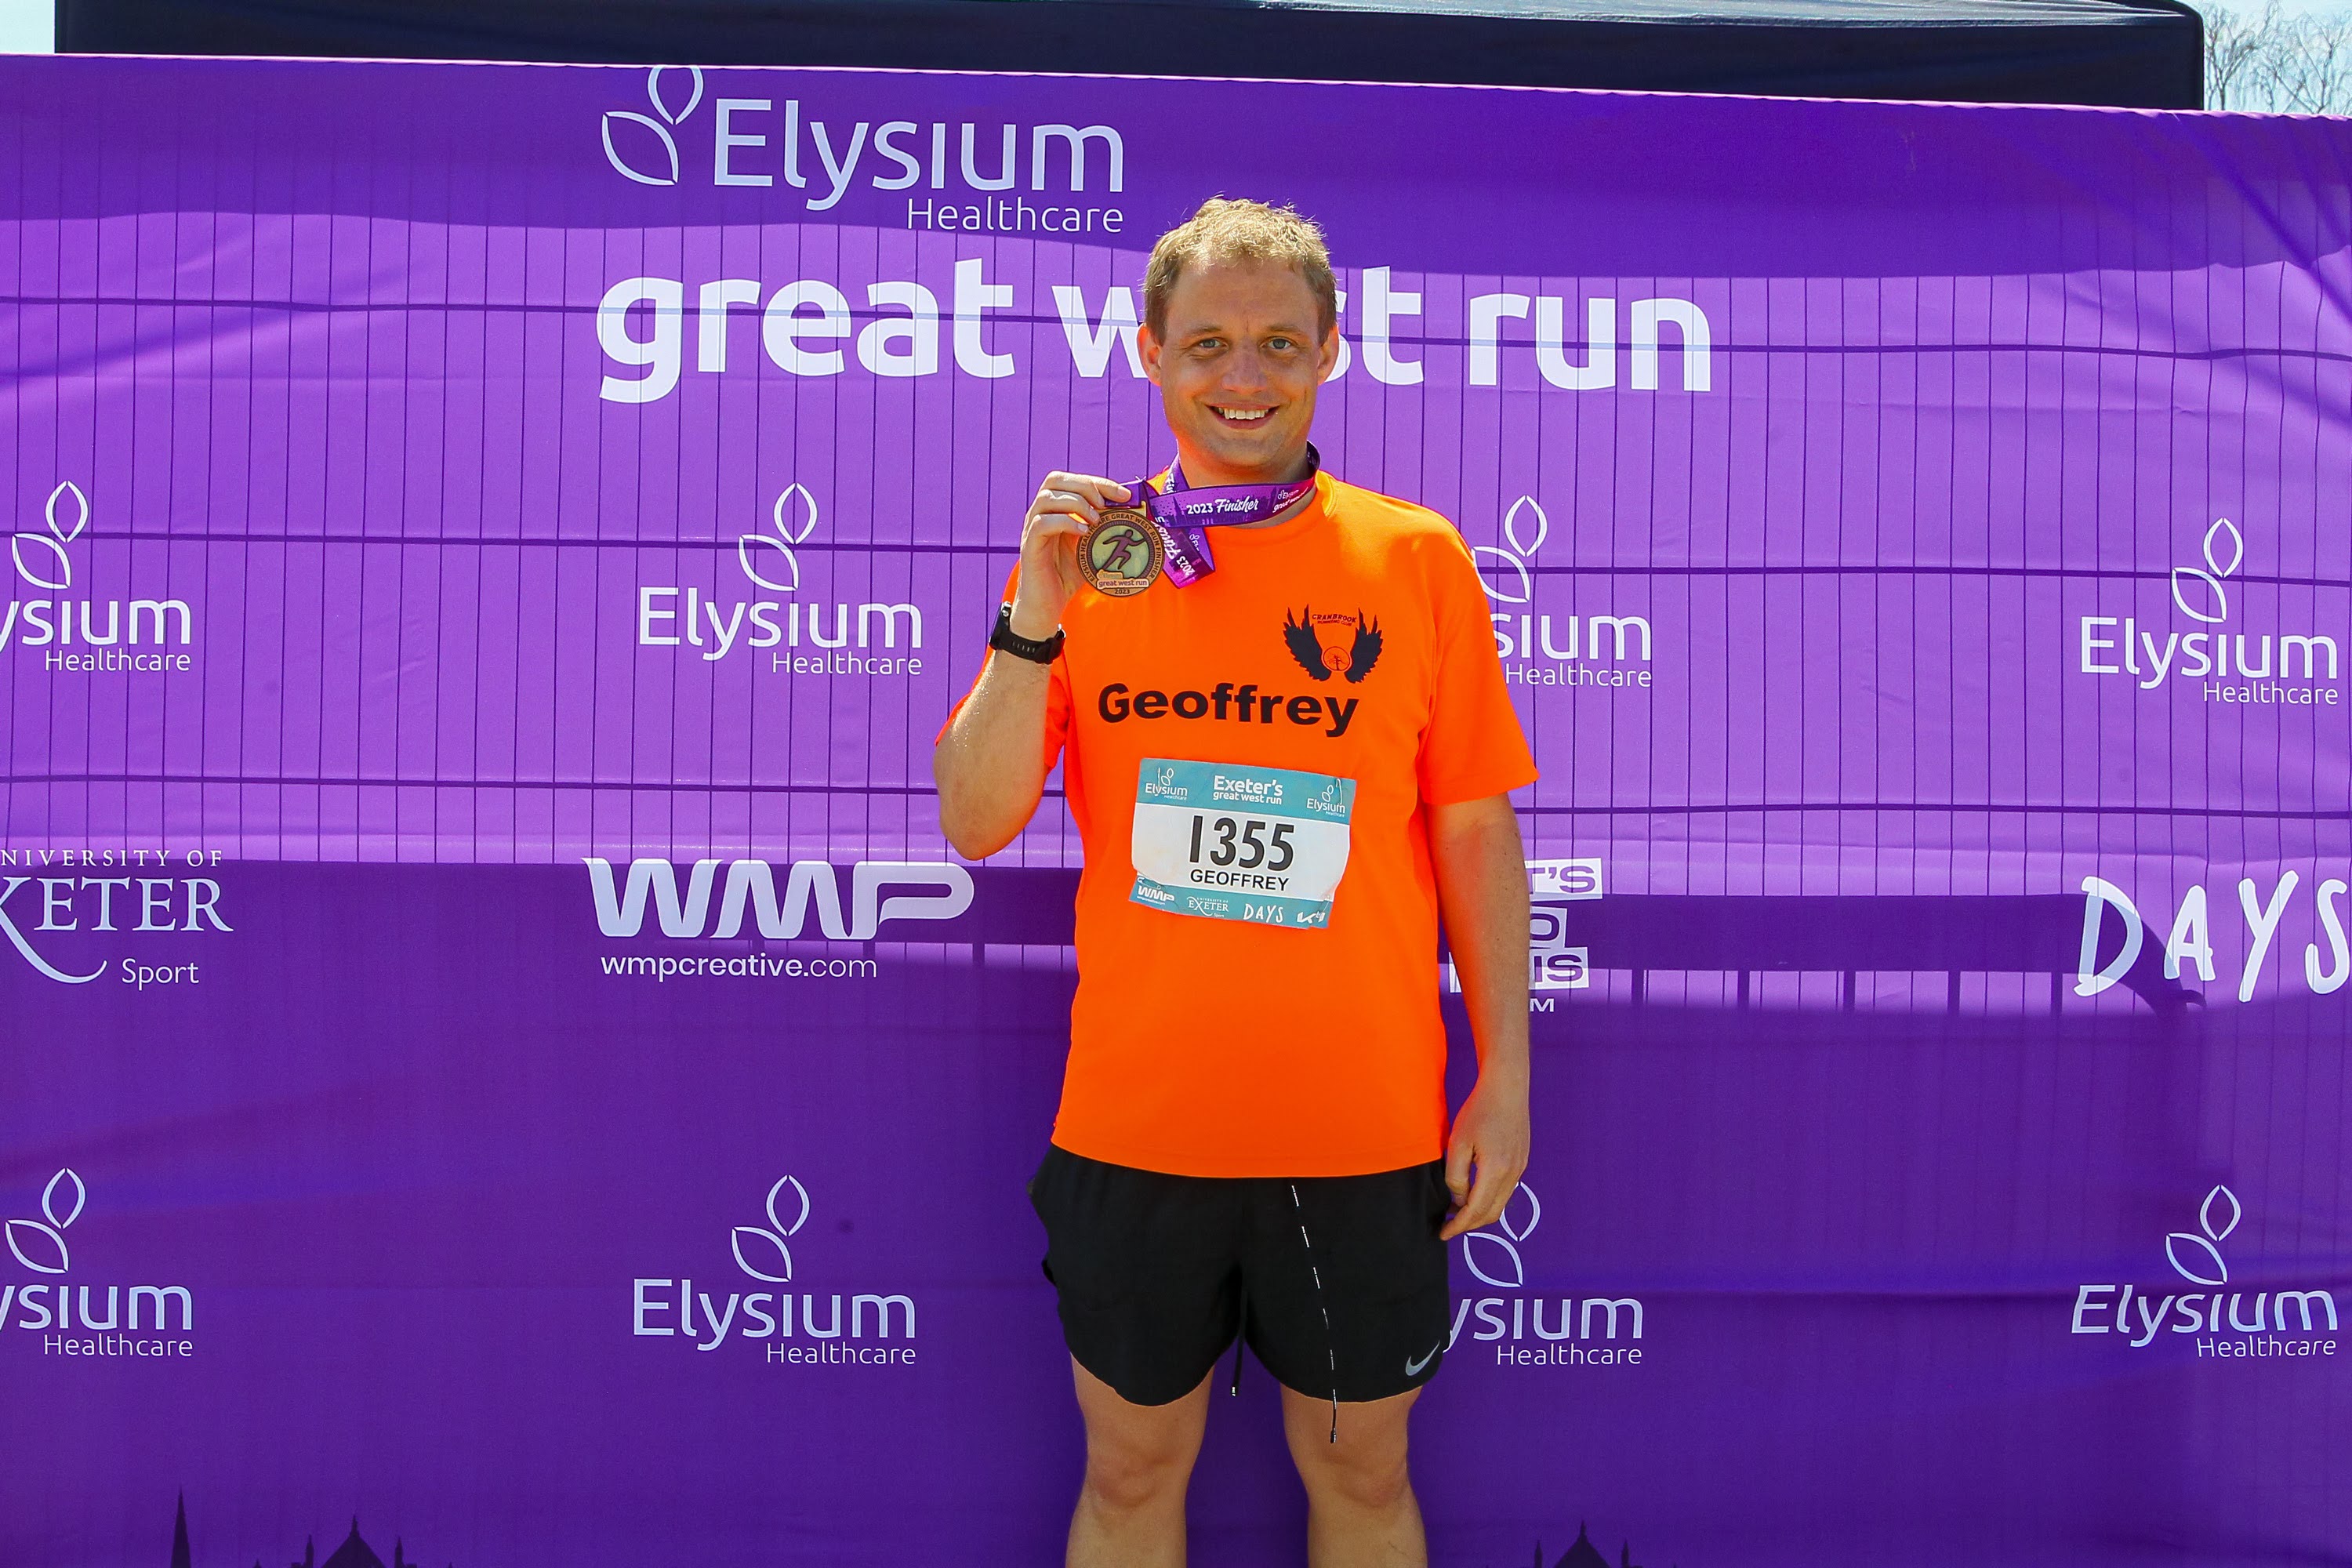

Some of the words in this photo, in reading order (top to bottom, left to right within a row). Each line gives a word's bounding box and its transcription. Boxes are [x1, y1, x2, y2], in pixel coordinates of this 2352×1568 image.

[714, 98, 1124, 211] Elysium
[907, 197, 1124, 234] Healthcare
[596, 257, 1015, 405] great
[1469, 292, 1711, 393] run
[1186, 503, 1213, 514] 2023
[1214, 495, 1258, 513] Finisher
[1135, 518, 1152, 532] WEST
[1150, 530, 1160, 546] RUN
[1080, 554, 1096, 582] ELYSIUM
[1149, 546, 1162, 579] FINISHER
[1176, 555, 1196, 576] 2023
[639, 586, 922, 662] Elysium
[1312, 613, 1357, 623] CRANBROOK
[45, 648, 191, 672] Healthcare
[772, 651, 923, 675] Healthcare
[2081, 616, 2337, 690] Elysium
[1505, 662, 1652, 687] Healthcare
[2203, 681, 2338, 705] Healthcare
[1098, 682, 1359, 738] Geoffrey
[1145, 782, 1188, 797] Elysium
[1213, 791, 1240, 801] great
[1241, 793, 1265, 803] west
[1265, 797, 1282, 805] run
[1214, 775, 1283, 797] Exeter's
[1306, 797, 1345, 814] Elysium
[1189, 815, 1295, 872] 1355
[187, 849, 223, 867] OF
[1190, 869, 1290, 891] GEOFFREY
[581, 857, 975, 940] WMP
[1138, 885, 1175, 902] WMP
[1186, 896, 1229, 916] EXETER
[1243, 903, 1283, 924] DAYS
[2073, 869, 2350, 1003] DAYS
[122, 958, 199, 991] Sport
[601, 953, 877, 982] wmpcreative.com
[633, 1278, 916, 1351] Elysium
[2071, 1283, 2338, 1348] Elysium
[44, 1333, 193, 1356] Healthcare
[766, 1341, 916, 1365] Healthcare
[1497, 1343, 1642, 1365] Healthcare
[2196, 1334, 2337, 1358] Healthcare
